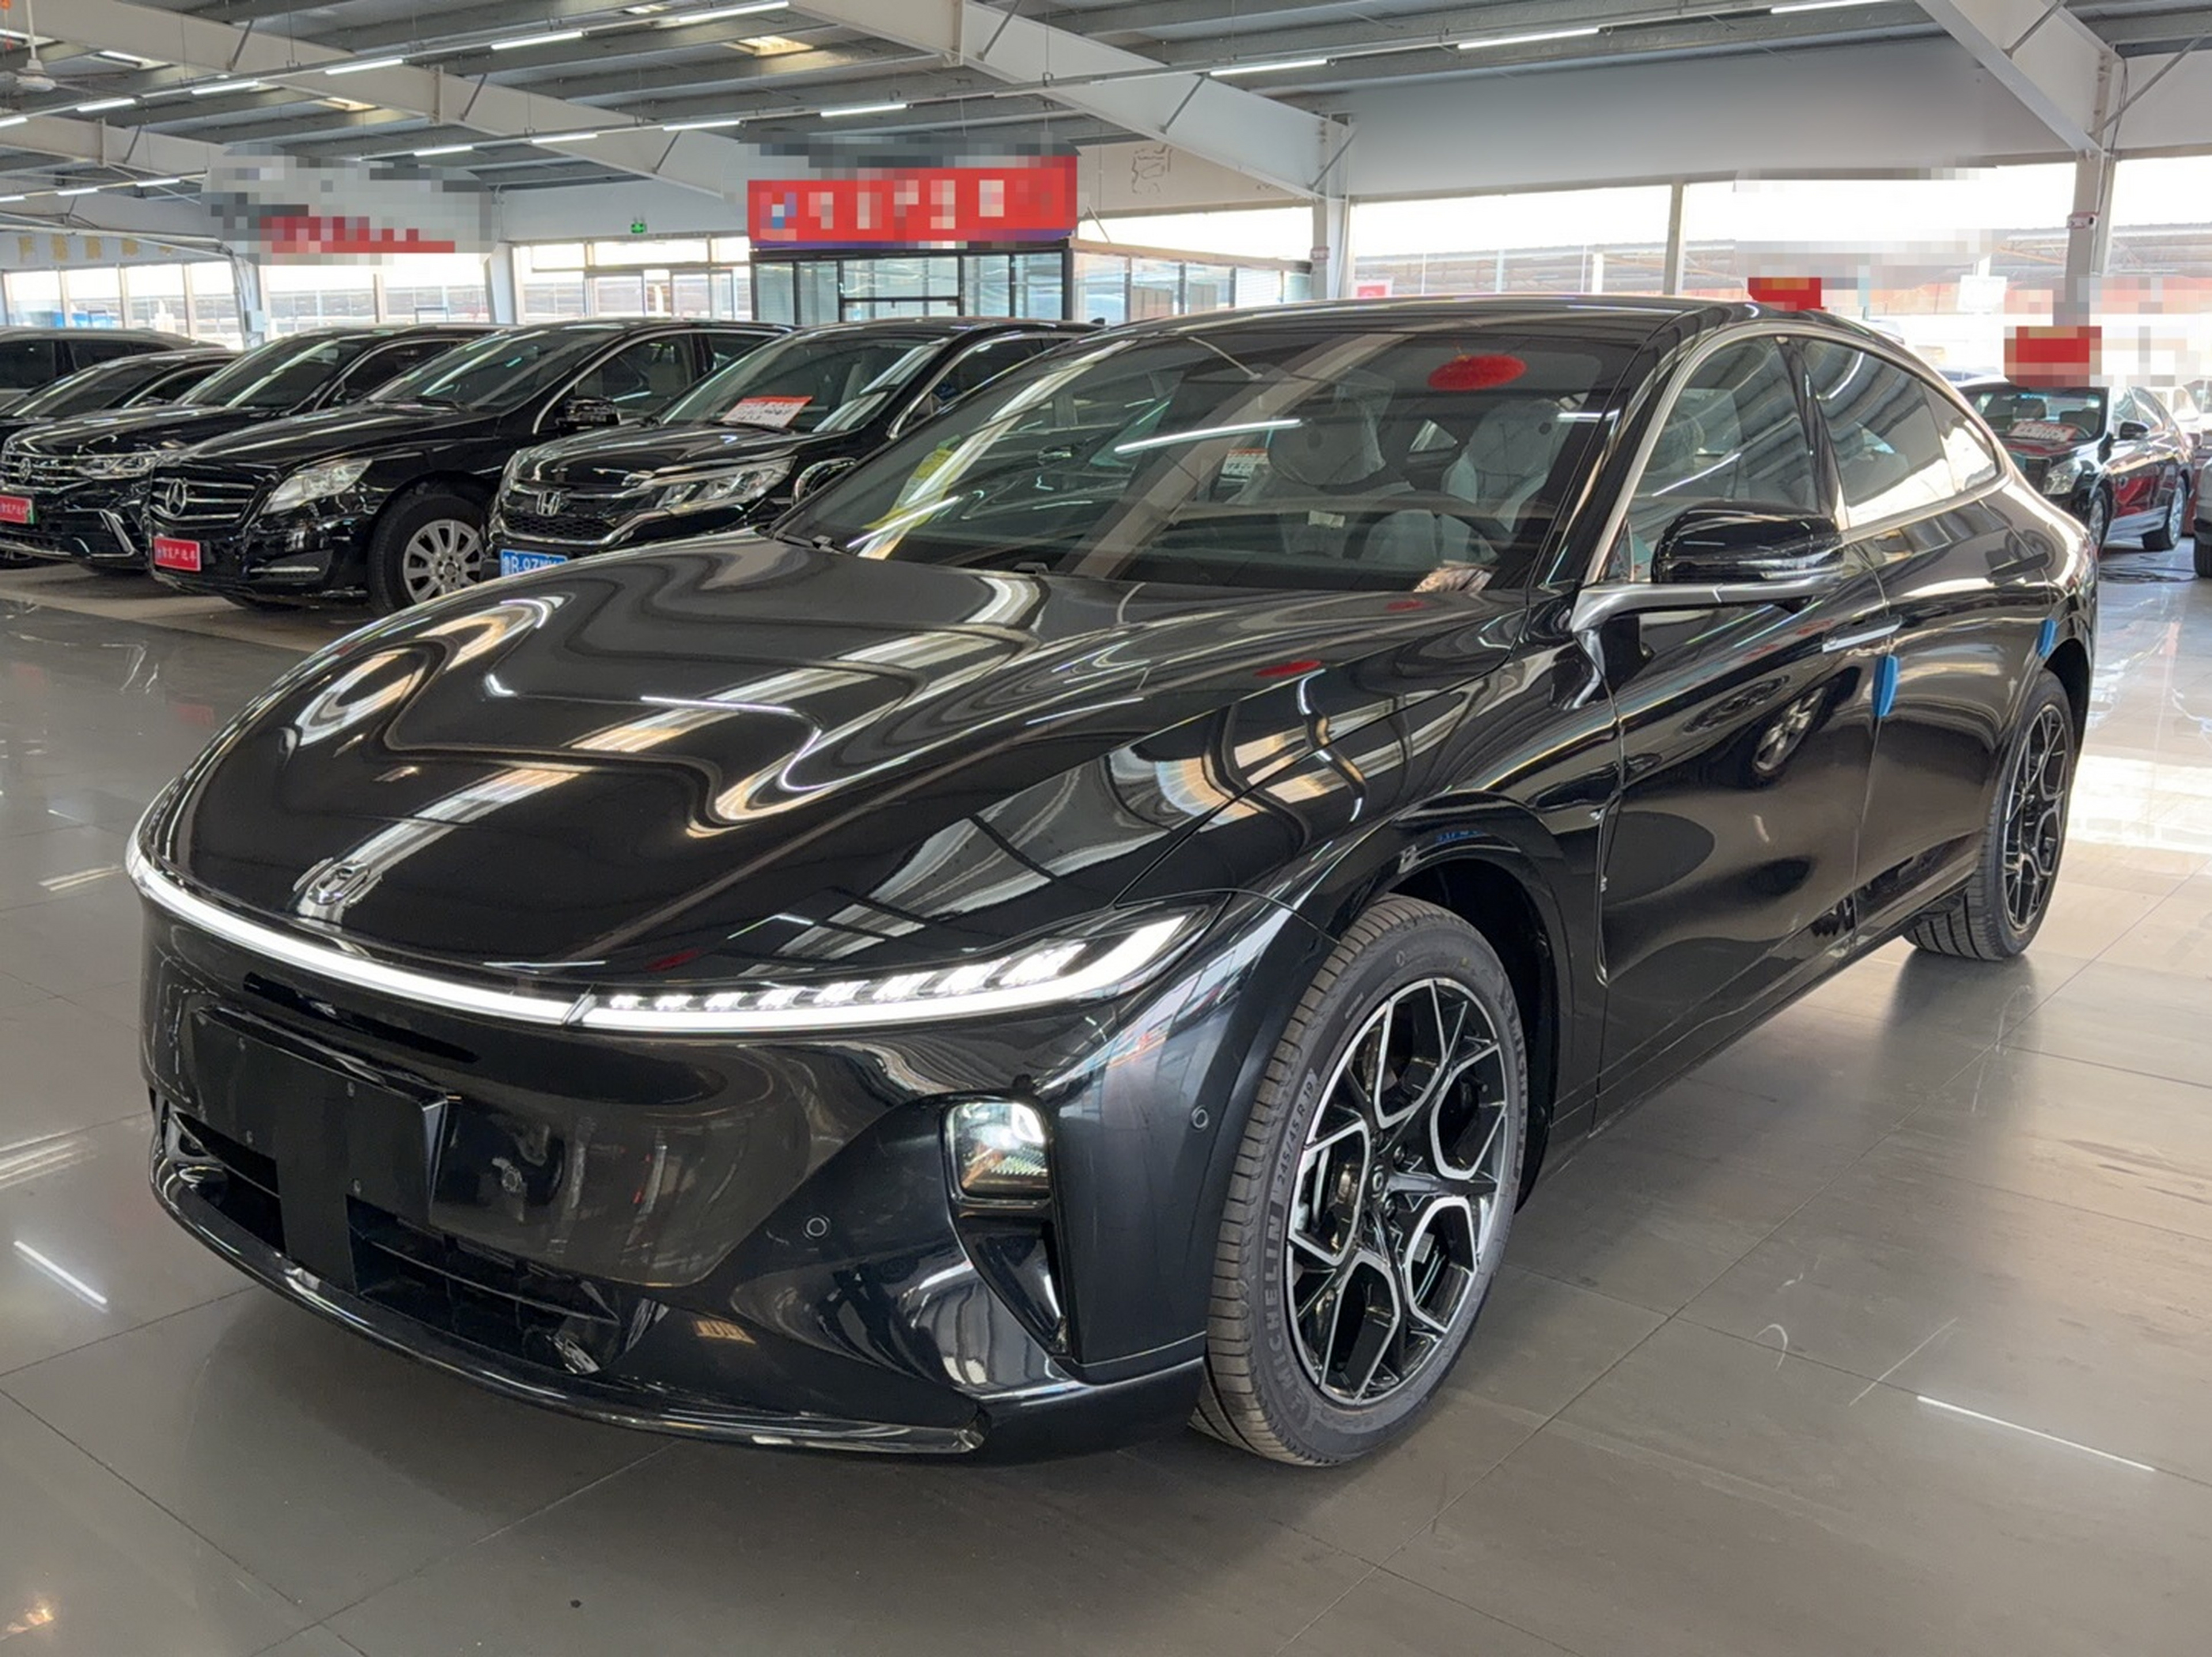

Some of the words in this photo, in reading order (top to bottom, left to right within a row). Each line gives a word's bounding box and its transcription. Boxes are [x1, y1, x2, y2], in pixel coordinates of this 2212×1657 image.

[1277, 1119, 1300, 1185] 245/45
[1297, 1104, 1305, 1117] R
[1304, 1081, 1313, 1099] 19
[1265, 1215, 1291, 1387] MICHELIN
